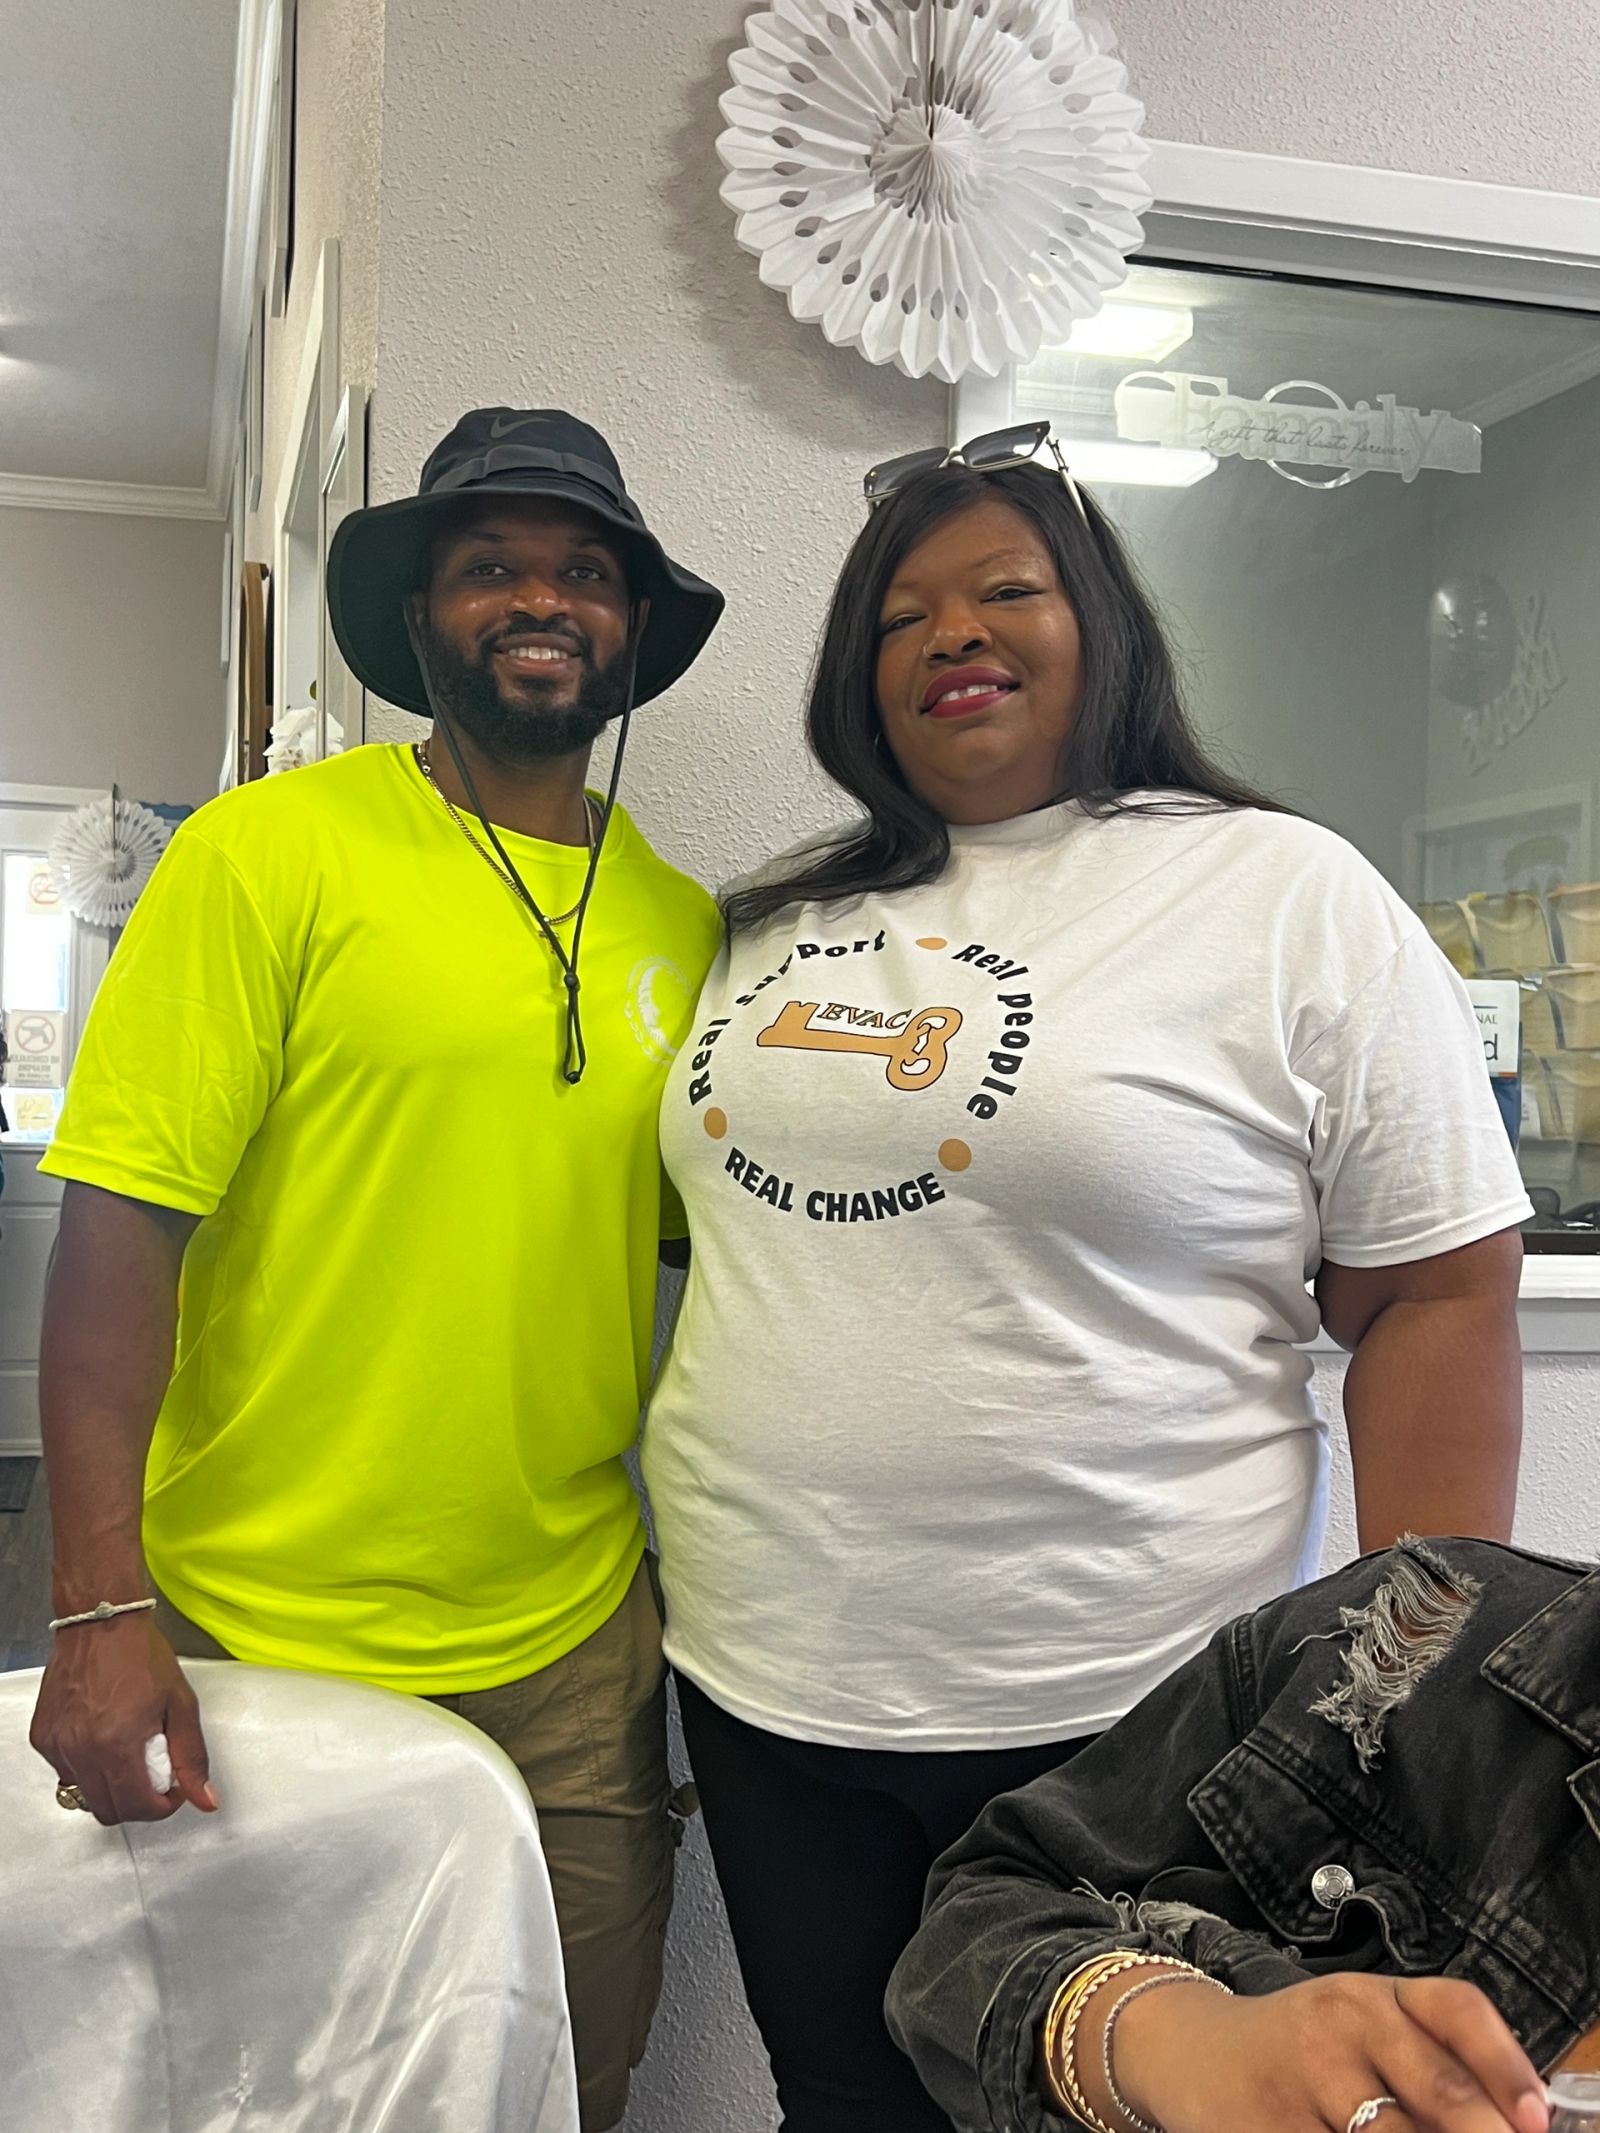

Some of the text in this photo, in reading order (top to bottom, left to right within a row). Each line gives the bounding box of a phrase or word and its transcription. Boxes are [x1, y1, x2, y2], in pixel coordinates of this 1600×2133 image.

[1208, 418, 1264, 448] gift
[1265, 422, 1304, 445] that
[689, 1018, 731, 1105] Real
[952, 945, 1033, 1119] Real people
[725, 1148, 945, 1222] REAL CHANGE
